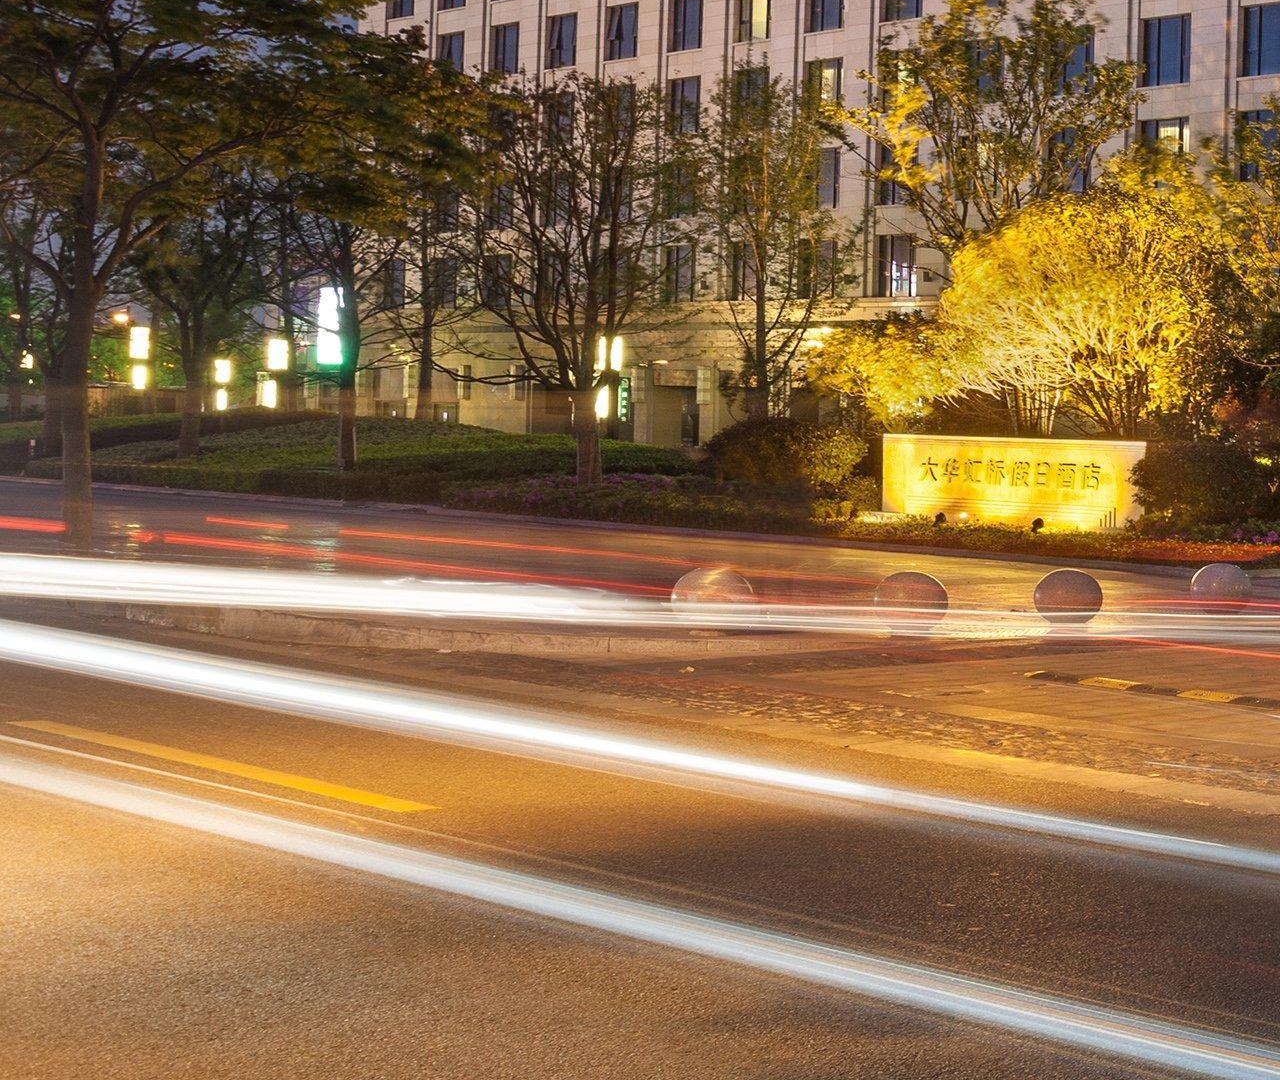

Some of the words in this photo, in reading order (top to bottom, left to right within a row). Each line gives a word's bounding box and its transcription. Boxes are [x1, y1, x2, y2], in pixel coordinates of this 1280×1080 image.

[920, 456, 1101, 491] 大华虹桥假日酒店
